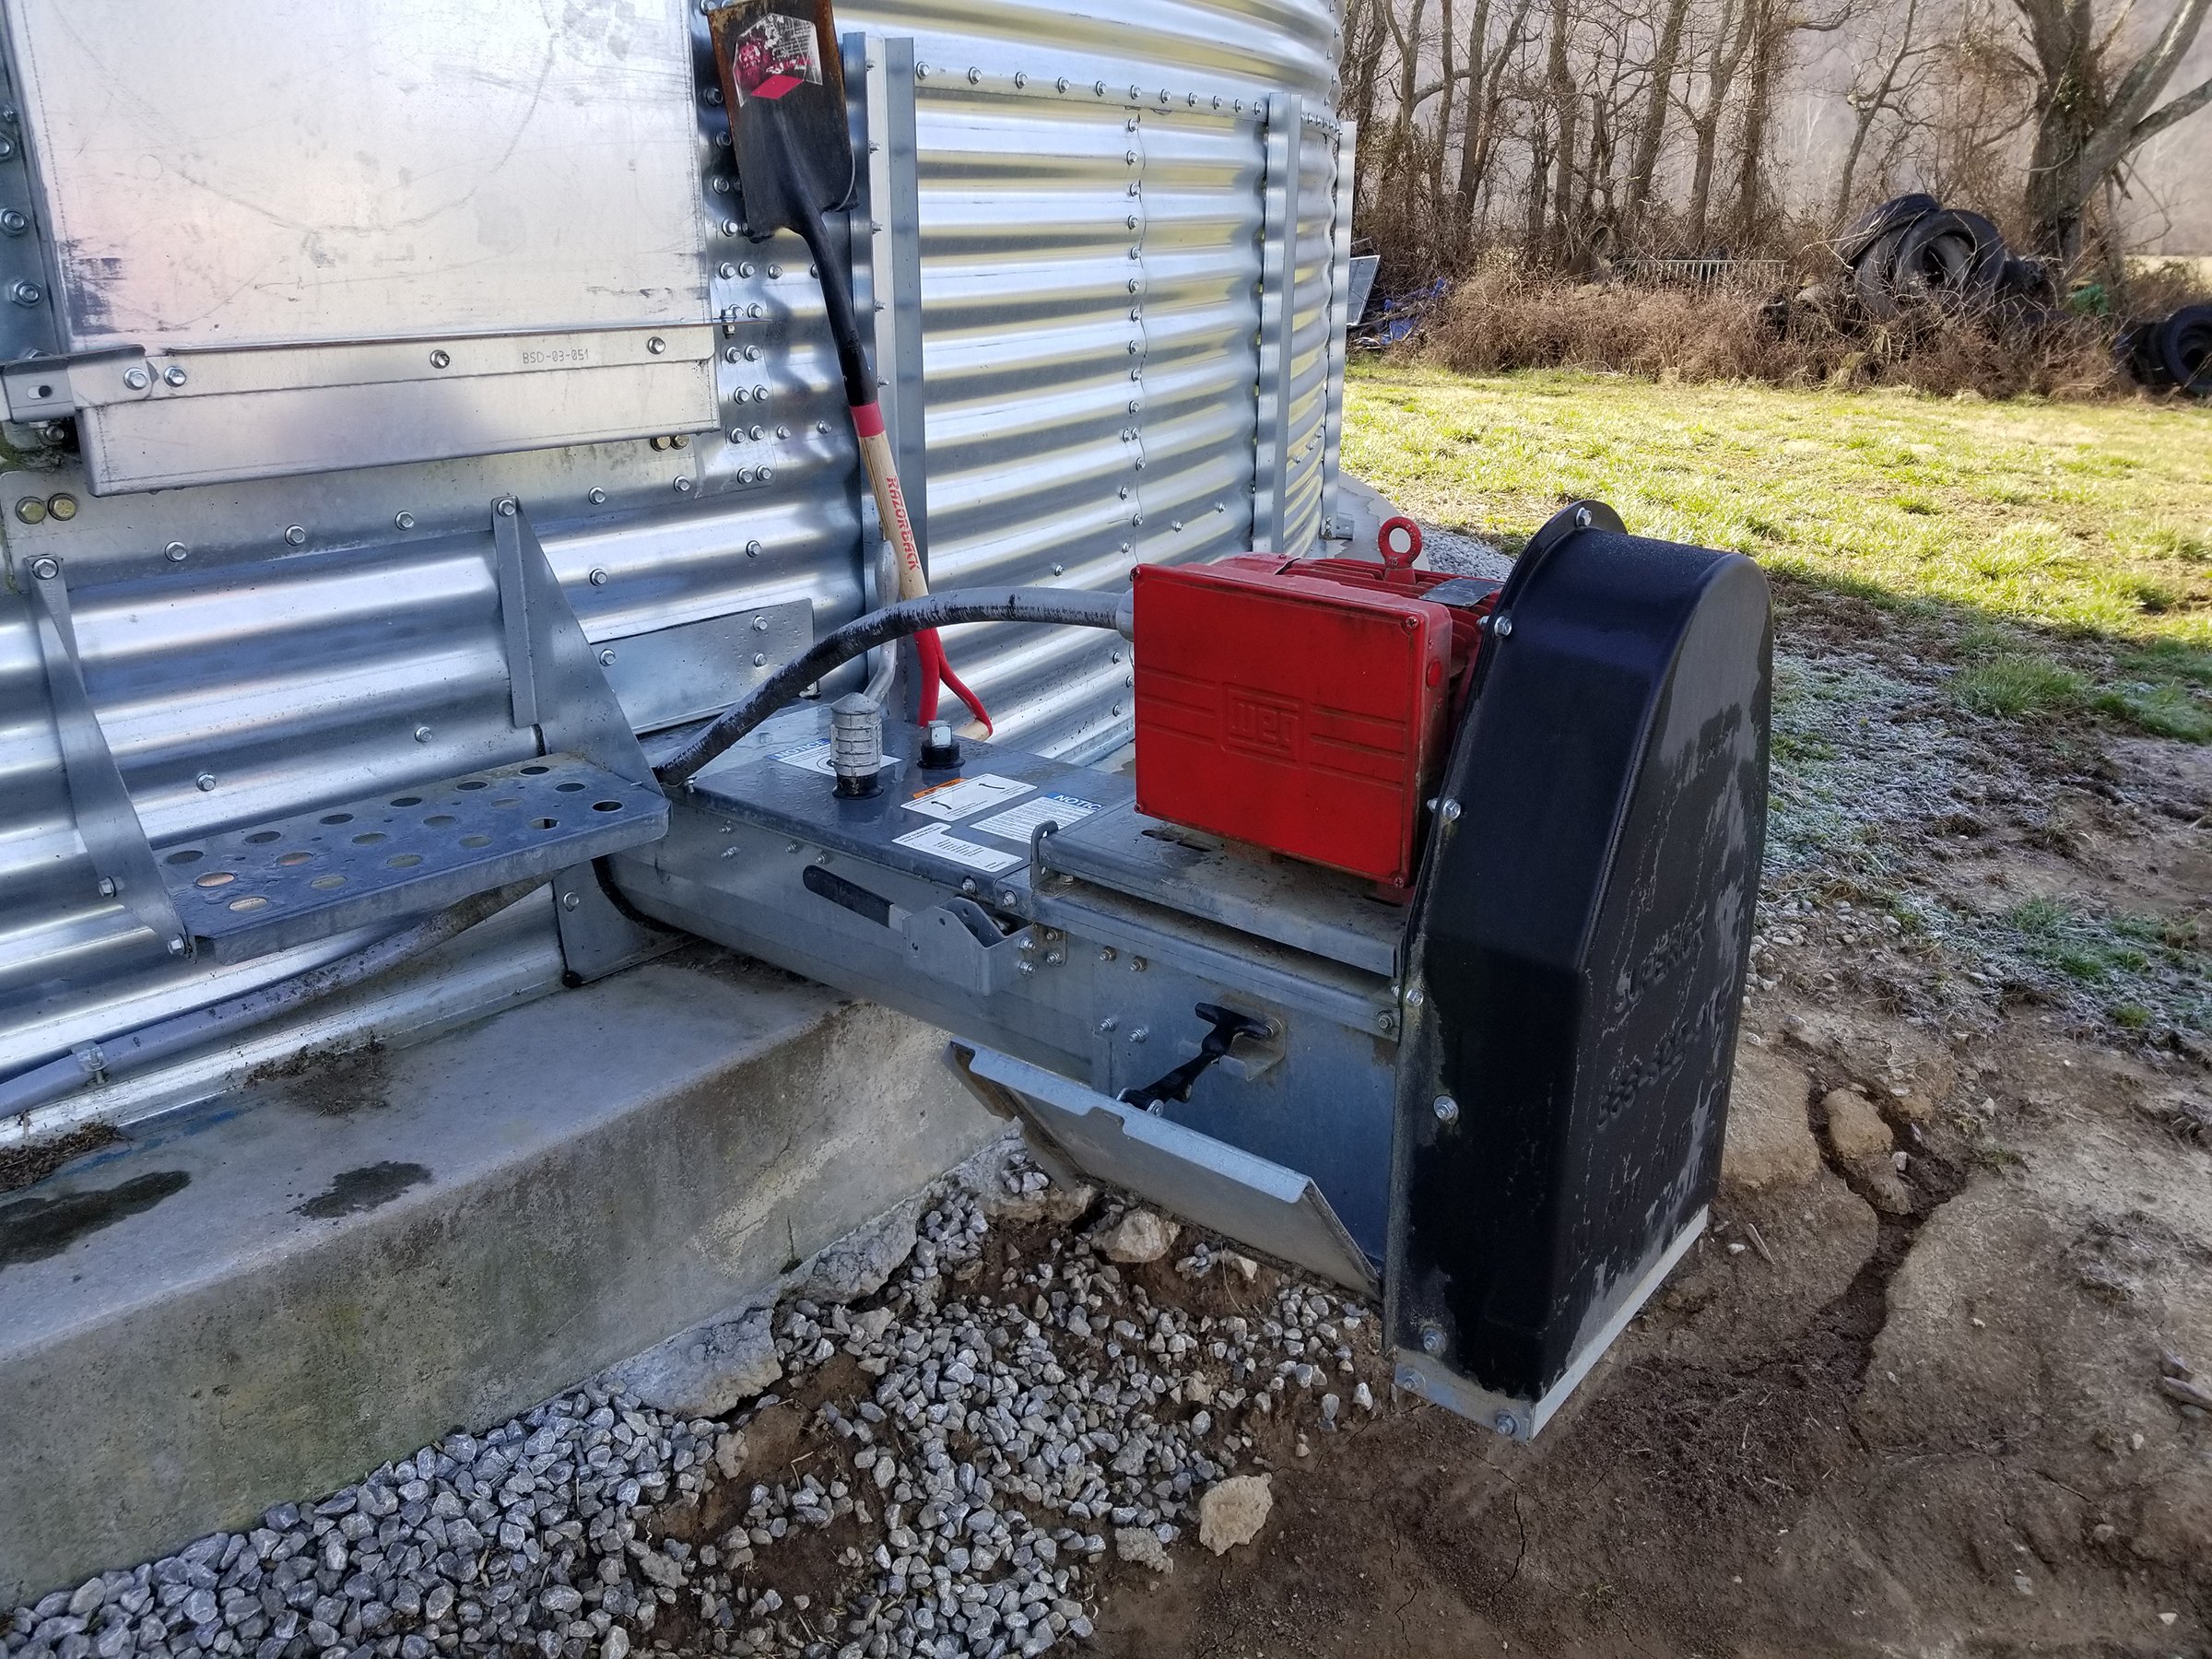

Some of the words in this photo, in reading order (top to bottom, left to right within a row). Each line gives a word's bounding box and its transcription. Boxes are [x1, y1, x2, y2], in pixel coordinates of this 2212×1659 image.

[522, 349, 589, 364] BSD-03-051
[887, 477, 920, 571] RAZORBACK
[1053, 794, 1105, 811] NOTIC
